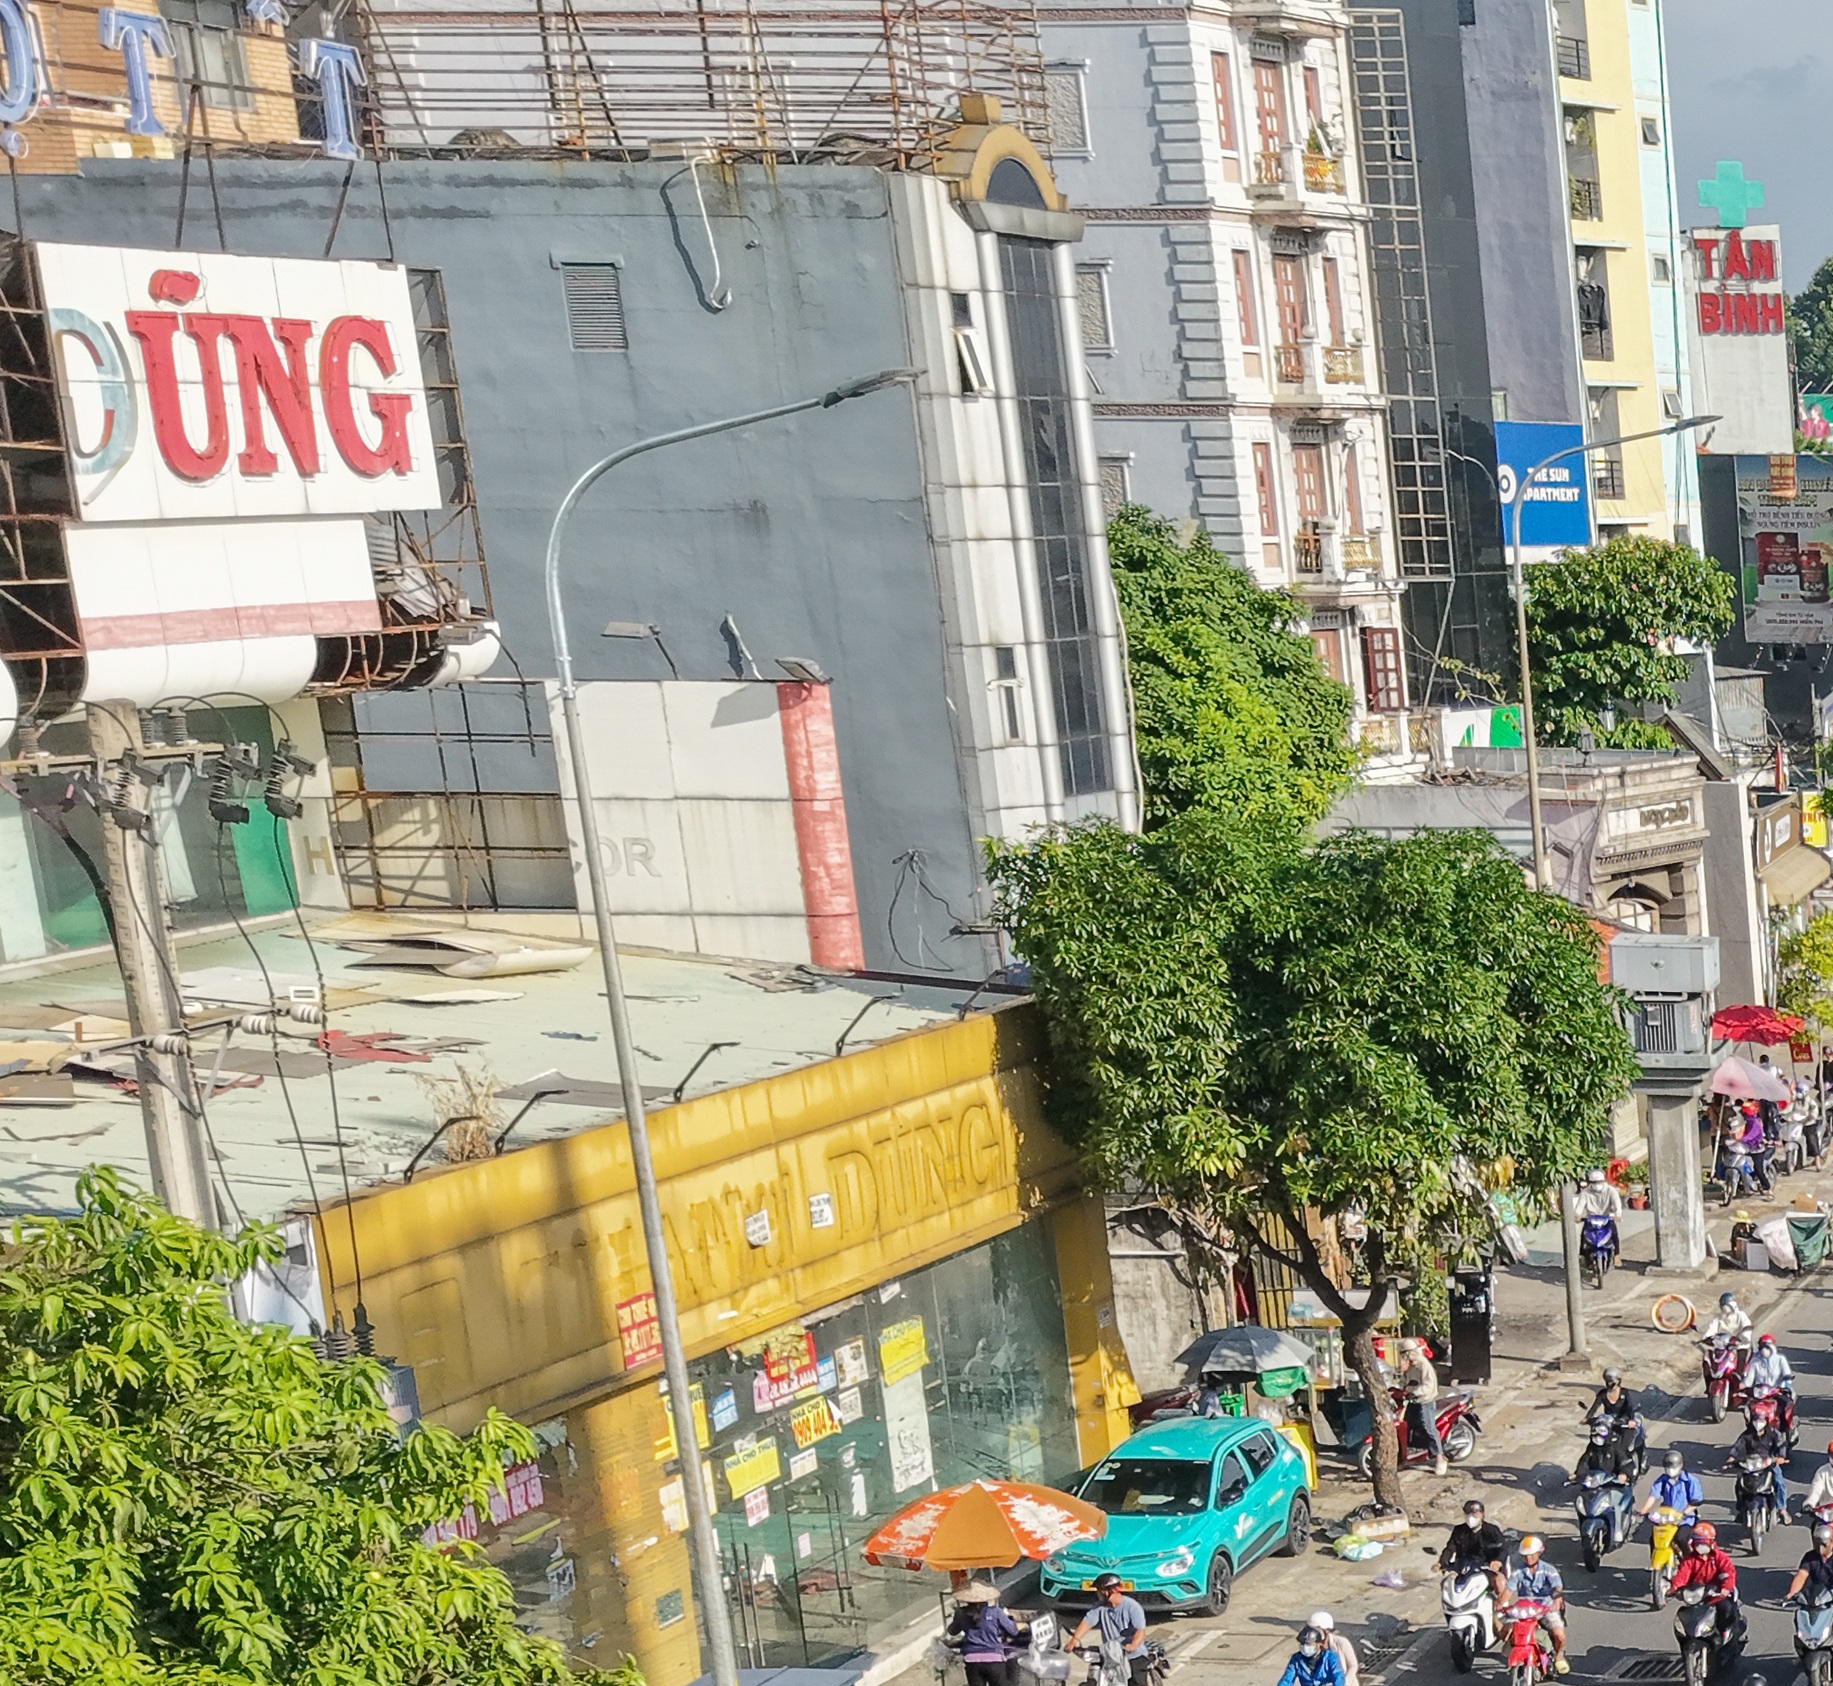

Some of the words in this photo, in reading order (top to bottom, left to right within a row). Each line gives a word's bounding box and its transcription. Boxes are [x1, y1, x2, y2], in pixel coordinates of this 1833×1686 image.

[1695, 230, 1775, 279] TÂN
[1699, 283, 1783, 334] BÌNH
[1549, 467, 1569, 482] SUN
